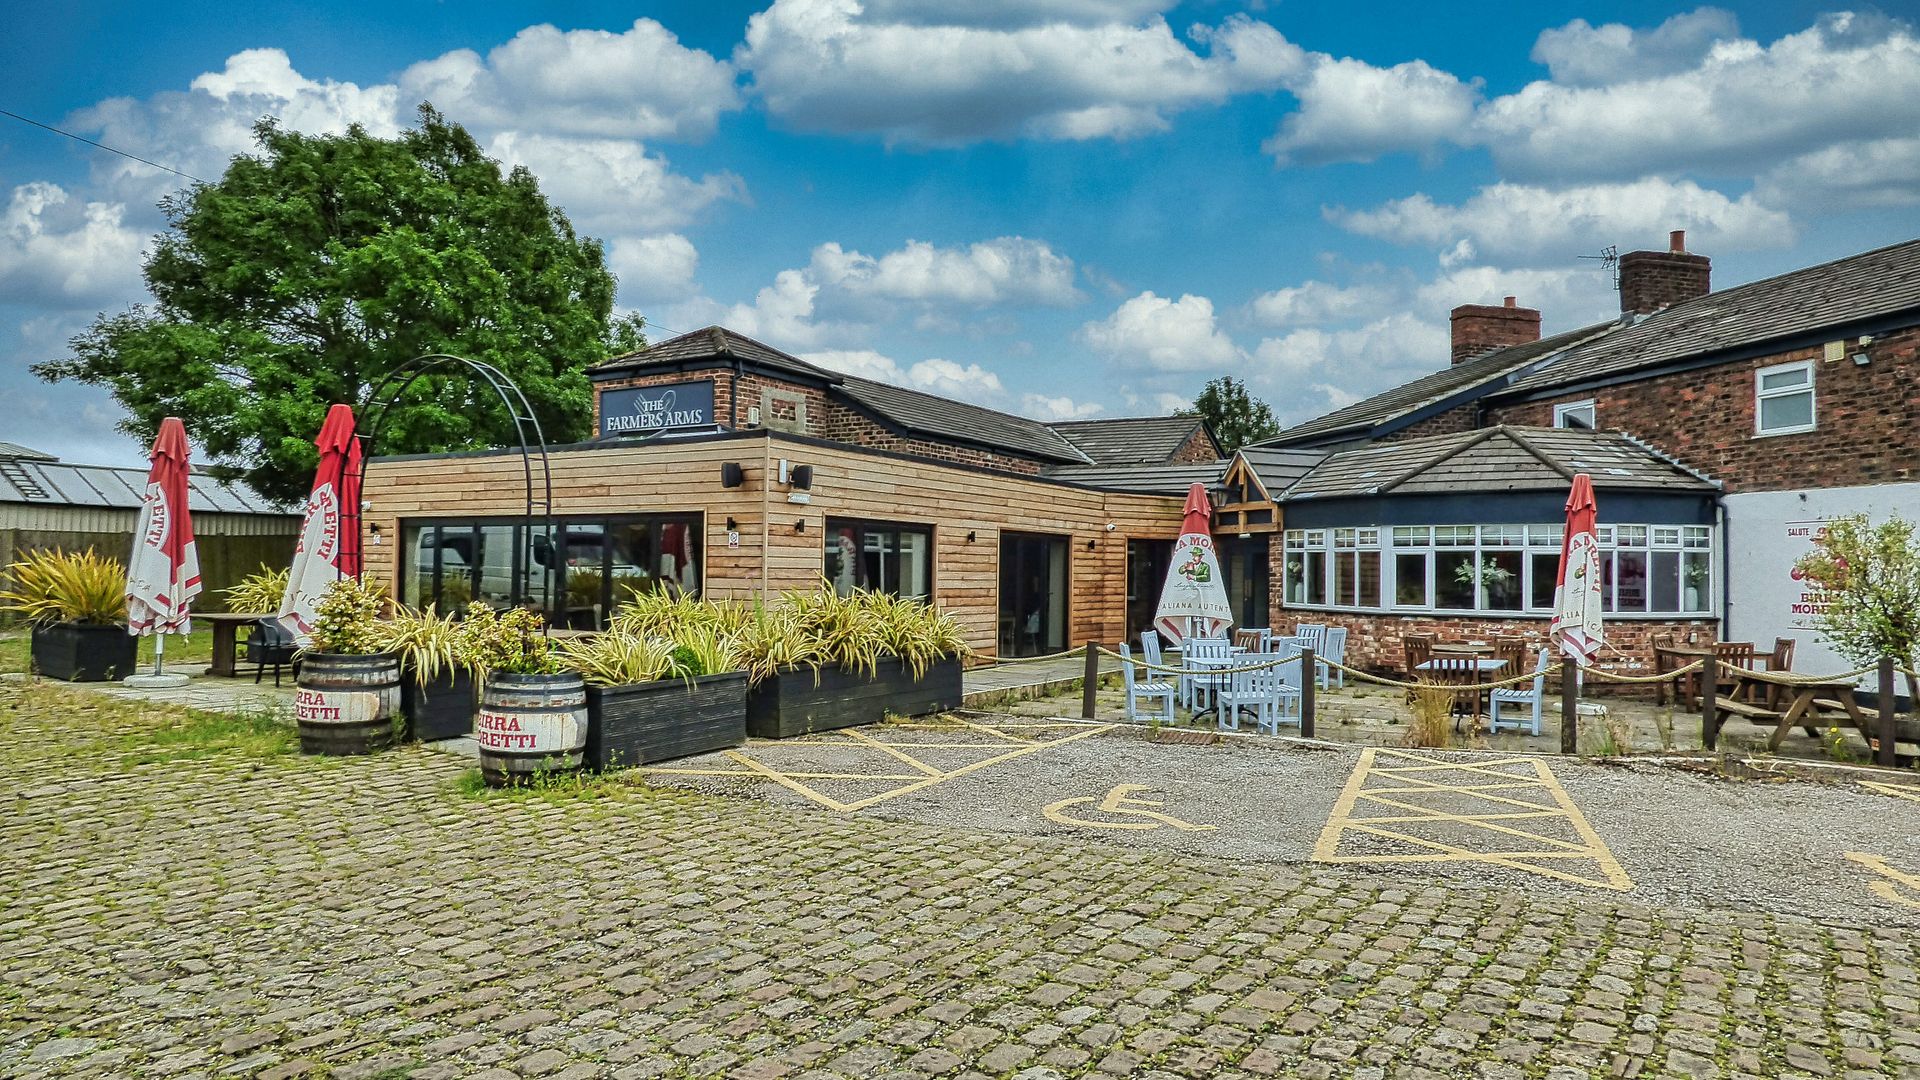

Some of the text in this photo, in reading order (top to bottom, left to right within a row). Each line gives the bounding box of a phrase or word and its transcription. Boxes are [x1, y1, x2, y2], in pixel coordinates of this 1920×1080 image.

[642, 400, 664, 412] THE
[607, 409, 703, 431] FARMERS ARMS
[1787, 527, 1810, 537] SALUTE
